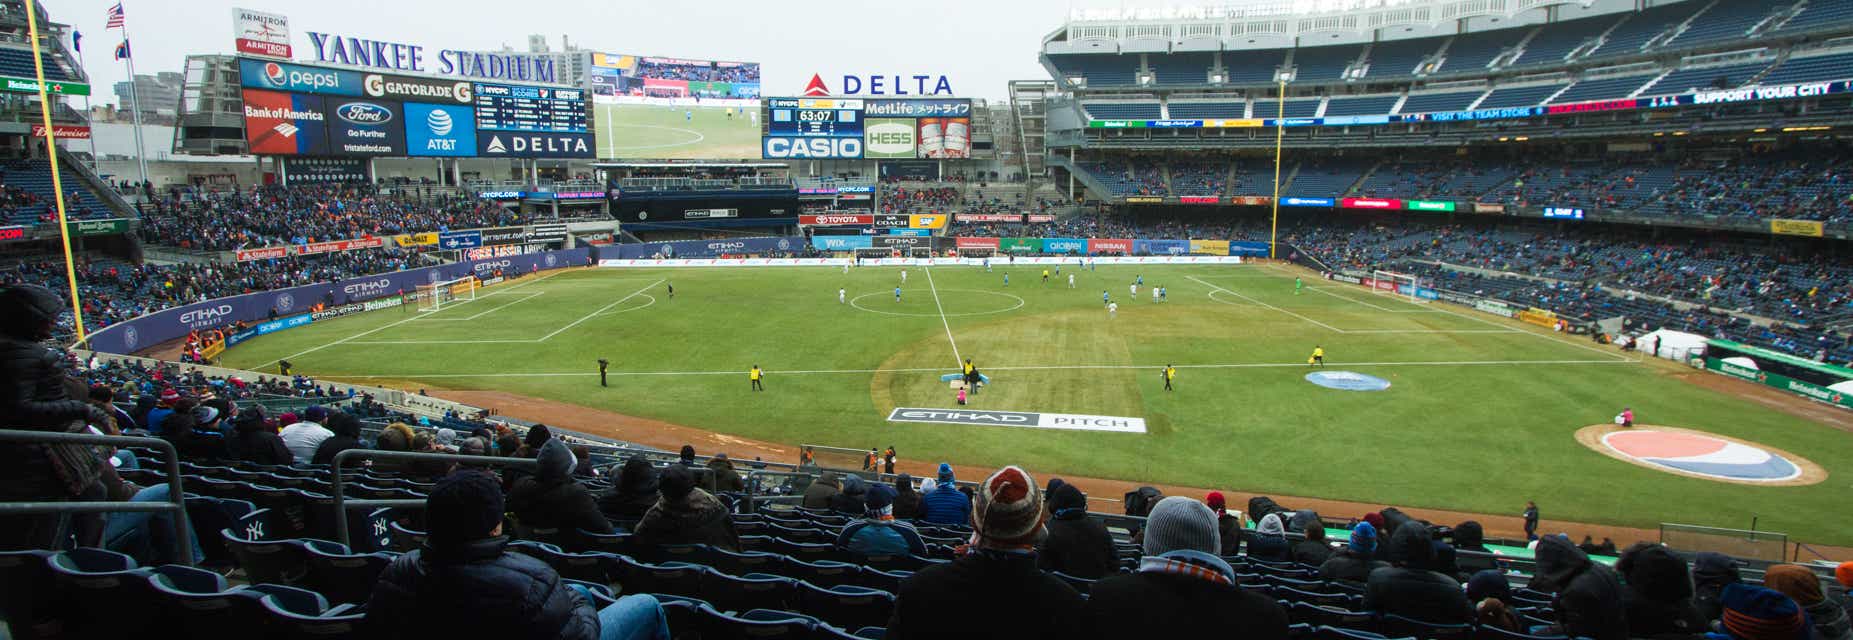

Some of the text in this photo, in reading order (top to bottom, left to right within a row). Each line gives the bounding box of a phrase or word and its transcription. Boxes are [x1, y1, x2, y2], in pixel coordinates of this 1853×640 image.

[240, 13, 286, 26] ARMITRON
[246, 40, 287, 52] ARMITRON
[306, 32, 556, 83] YANKEE STADIUM
[8, 80, 49, 90] Heinekn
[290, 72, 339, 89] pepsi
[843, 75, 953, 95] DELTA
[385, 83, 453, 98] GATORADE
[1694, 83, 1831, 104] SUPPORT YOUR CITY
[245, 106, 324, 121] Bank of America
[347, 104, 382, 122] Ford
[865, 102, 913, 114] MetLife
[917, 103, 970, 114] メットライフ
[1432, 108, 1530, 120] VISIT THE TEAM STORE
[800, 111, 831, 121] 63:07
[33, 126, 90, 137] Bdweiser
[348, 130, 386, 138] Go Further
[870, 132, 912, 144] HESS
[344, 144, 392, 153] tristateford.com
[427, 139, 457, 151] AT&T
[512, 136, 588, 153] DELTA
[767, 138, 862, 157] CASIO
[828, 216, 858, 224] TOYOTA
[920, 218, 934, 226] SAP
[708, 242, 744, 250] ETIHAD
[474, 260, 510, 271] ETIHAD
[344, 279, 390, 294] ETIHAD
[354, 289, 383, 298] AIRWAYS
[365, 300, 402, 312] Heineken
[180, 305, 232, 324] ETIHAD
[1720, 363, 1757, 380] Heineken
[1788, 380, 1832, 399] Heineken
[901, 411, 1129, 428] ETIHAD PITCH
